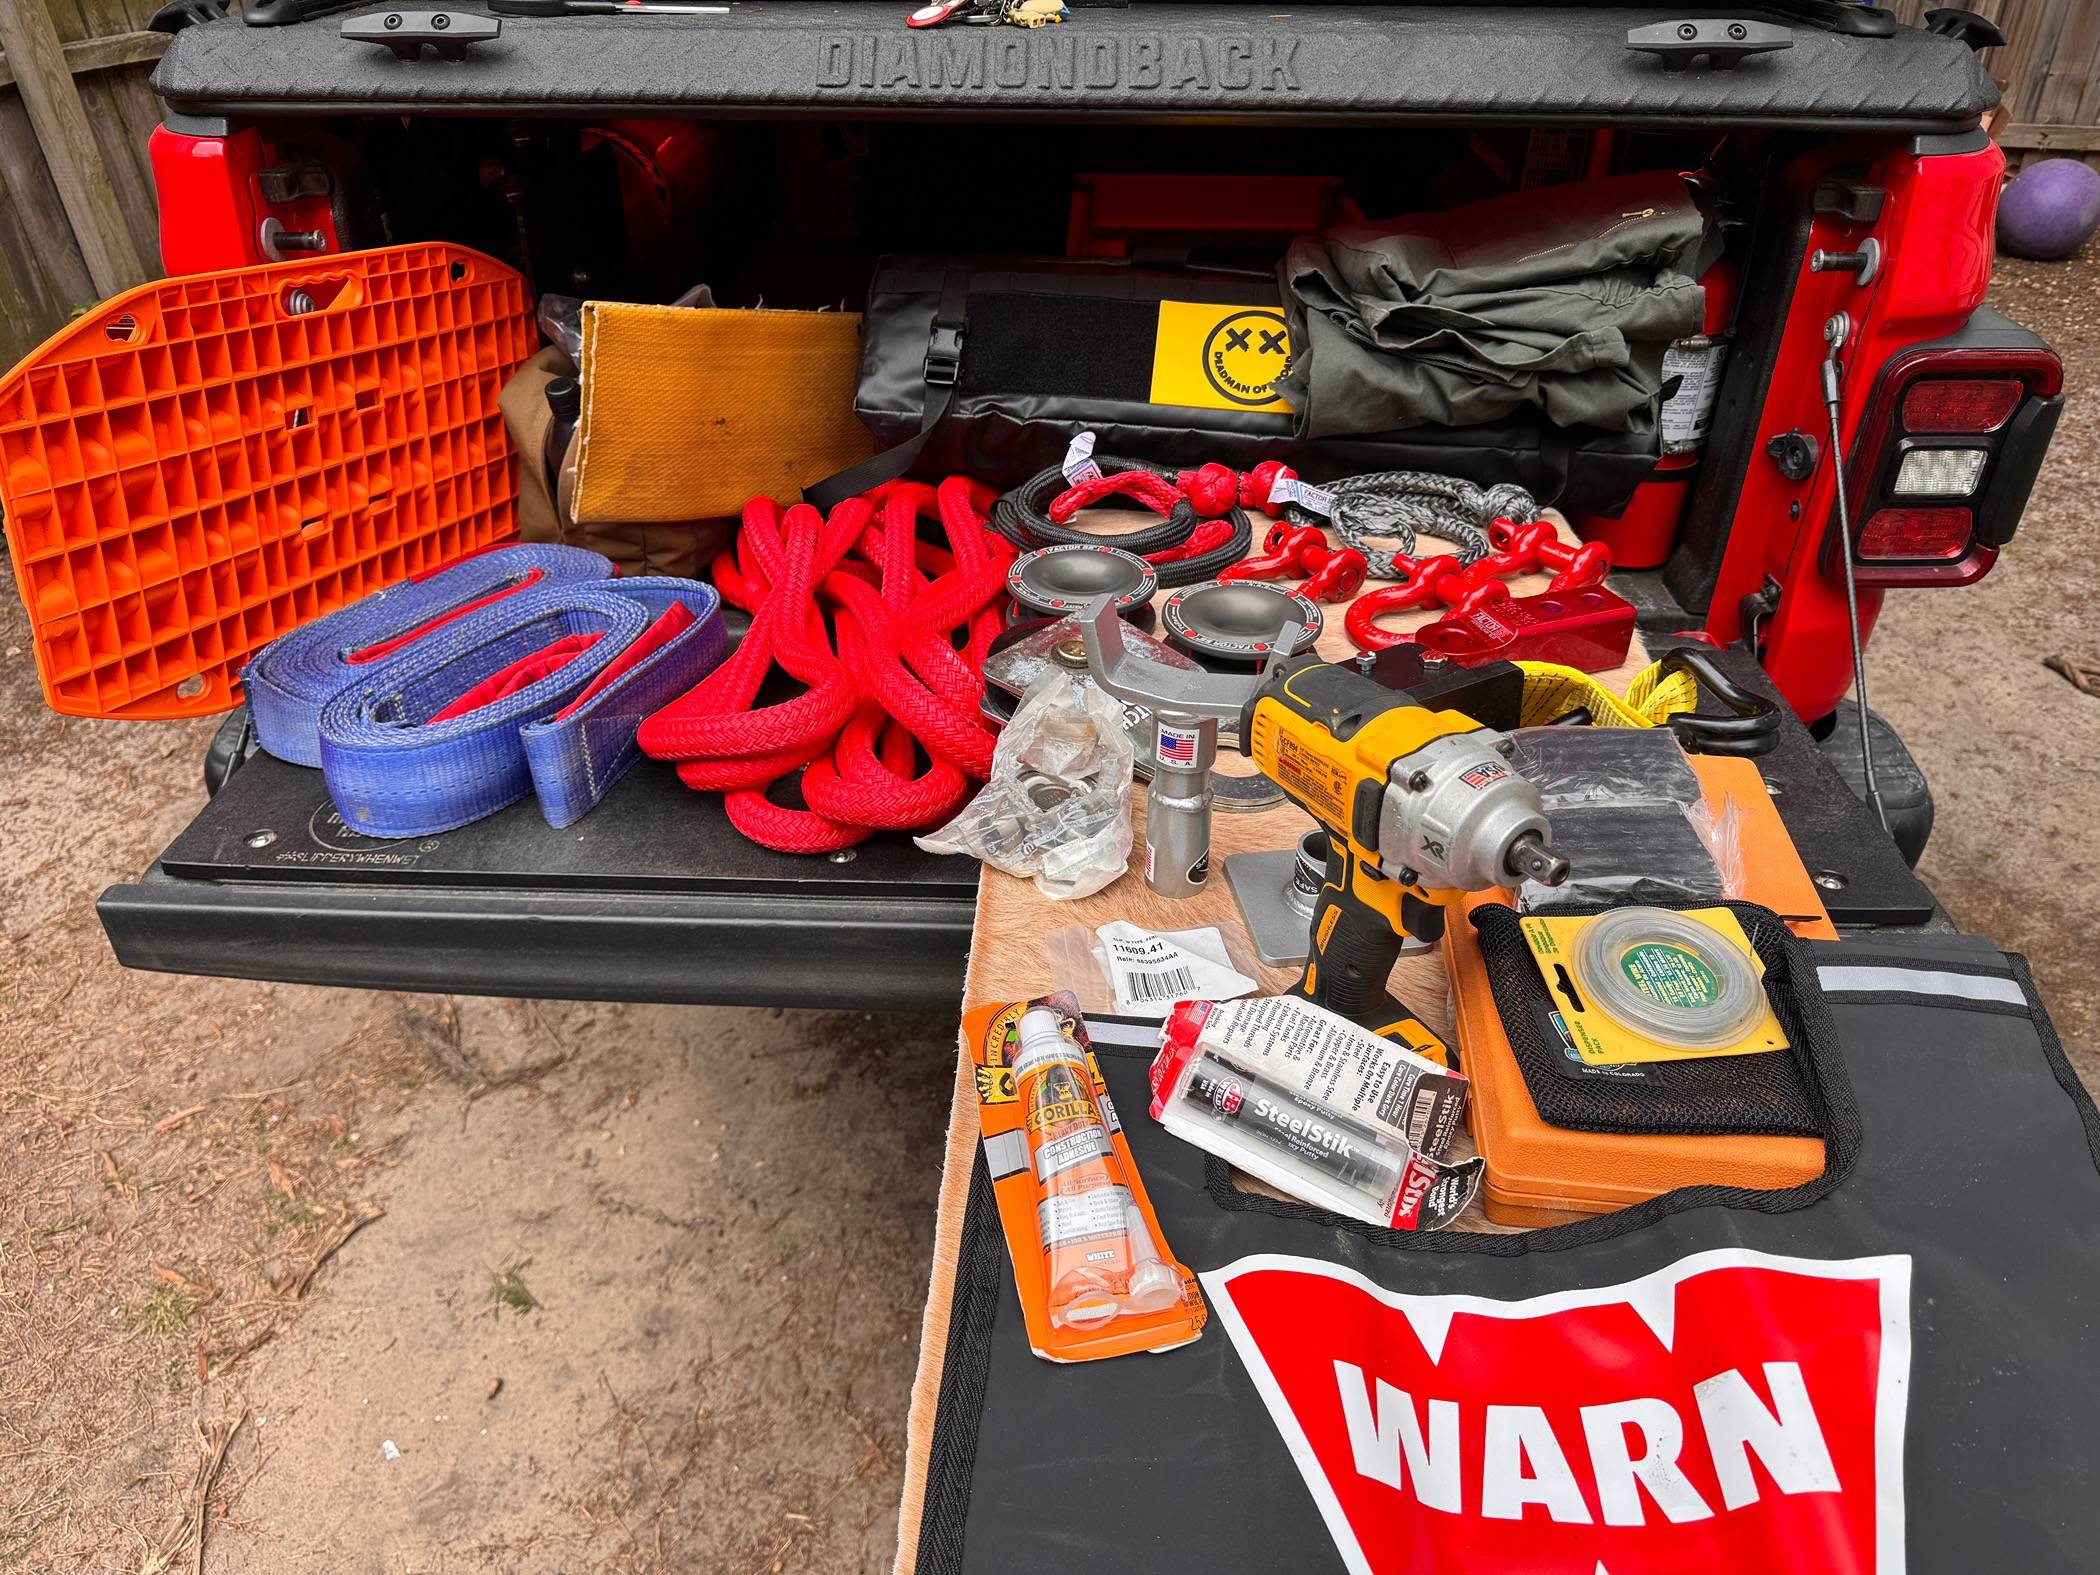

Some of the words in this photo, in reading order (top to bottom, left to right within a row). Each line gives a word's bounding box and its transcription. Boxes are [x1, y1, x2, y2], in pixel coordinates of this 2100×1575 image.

[815, 34, 1302, 92] DIAMONDBACK
[1214, 351, 1251, 394] DEADMAN
[1252, 384, 1274, 394] OF
[1160, 729, 1185, 739] MADE
[1420, 834, 1446, 861] XR
[1113, 942, 1163, 955] 11609.41
[1234, 999, 1247, 1020] sehold
[1238, 1006, 1255, 1032] Damage
[1261, 1001, 1281, 1031] Plumbing
[1274, 1005, 1290, 1030] Exhaust
[1289, 1010, 1299, 1024] Fuel
[990, 1008, 1020, 1062] INCREDIBLY
[1222, 1020, 1238, 1044] Repairs
[1243, 1023, 1259, 1048] Threads
[1280, 1024, 1293, 1042] Tanks
[1292, 1015, 1308, 1041] Machine
[1295, 1018, 1316, 1055] Automotive
[1313, 1019, 1326, 1038] Great
[1261, 1029, 1278, 1056] Systems
[1284, 1041, 1296, 1058] Parts
[1307, 1039, 1317, 1053] For:
[1317, 1028, 1337, 1061] Aluminum
[1330, 1032, 1345, 1055] Copper
[1344, 1037, 1354, 1050] Iron
[1352, 1042, 1364, 1058] Steel
[1320, 1061, 1333, 1079] Brass
[1355, 1043, 1374, 1075] Surfaces:
[1369, 1048, 1383, 1069] Works
[1375, 1061, 1389, 1079] Easy
[1303, 1067, 1318, 1090] Bronze
[1329, 1057, 1346, 1085] Stainless
[1365, 1070, 1373, 1079] On
[1322, 1086, 1333, 1100] Stee
[1373, 1080, 1381, 1088] to
[1390, 1077, 1400, 1090] Color
[1400, 1086, 1409, 1100] Time
[1350, 1080, 1370, 1111] Multiple
[1367, 1090, 1378, 1103] Use
[1034, 1103, 1095, 1125] GORILLA
[1294, 1096, 1316, 1110] Epoxy
[1316, 1107, 1335, 1120] Putty
[1043, 1128, 1102, 1160] CONSTRUCTION
[1057, 1141, 1097, 1166] ADHESIVE
[1290, 1134, 1330, 1158] Reinforced
[1299, 1146, 1319, 1160] Putty
[1428, 1184, 1440, 1211] Bond
[1436, 1175, 1451, 1217] Strongest
[1447, 1175, 1460, 1210] World's
[1086, 1250, 1115, 1262] WHITE
[1332, 1360, 1843, 1527] WARN
